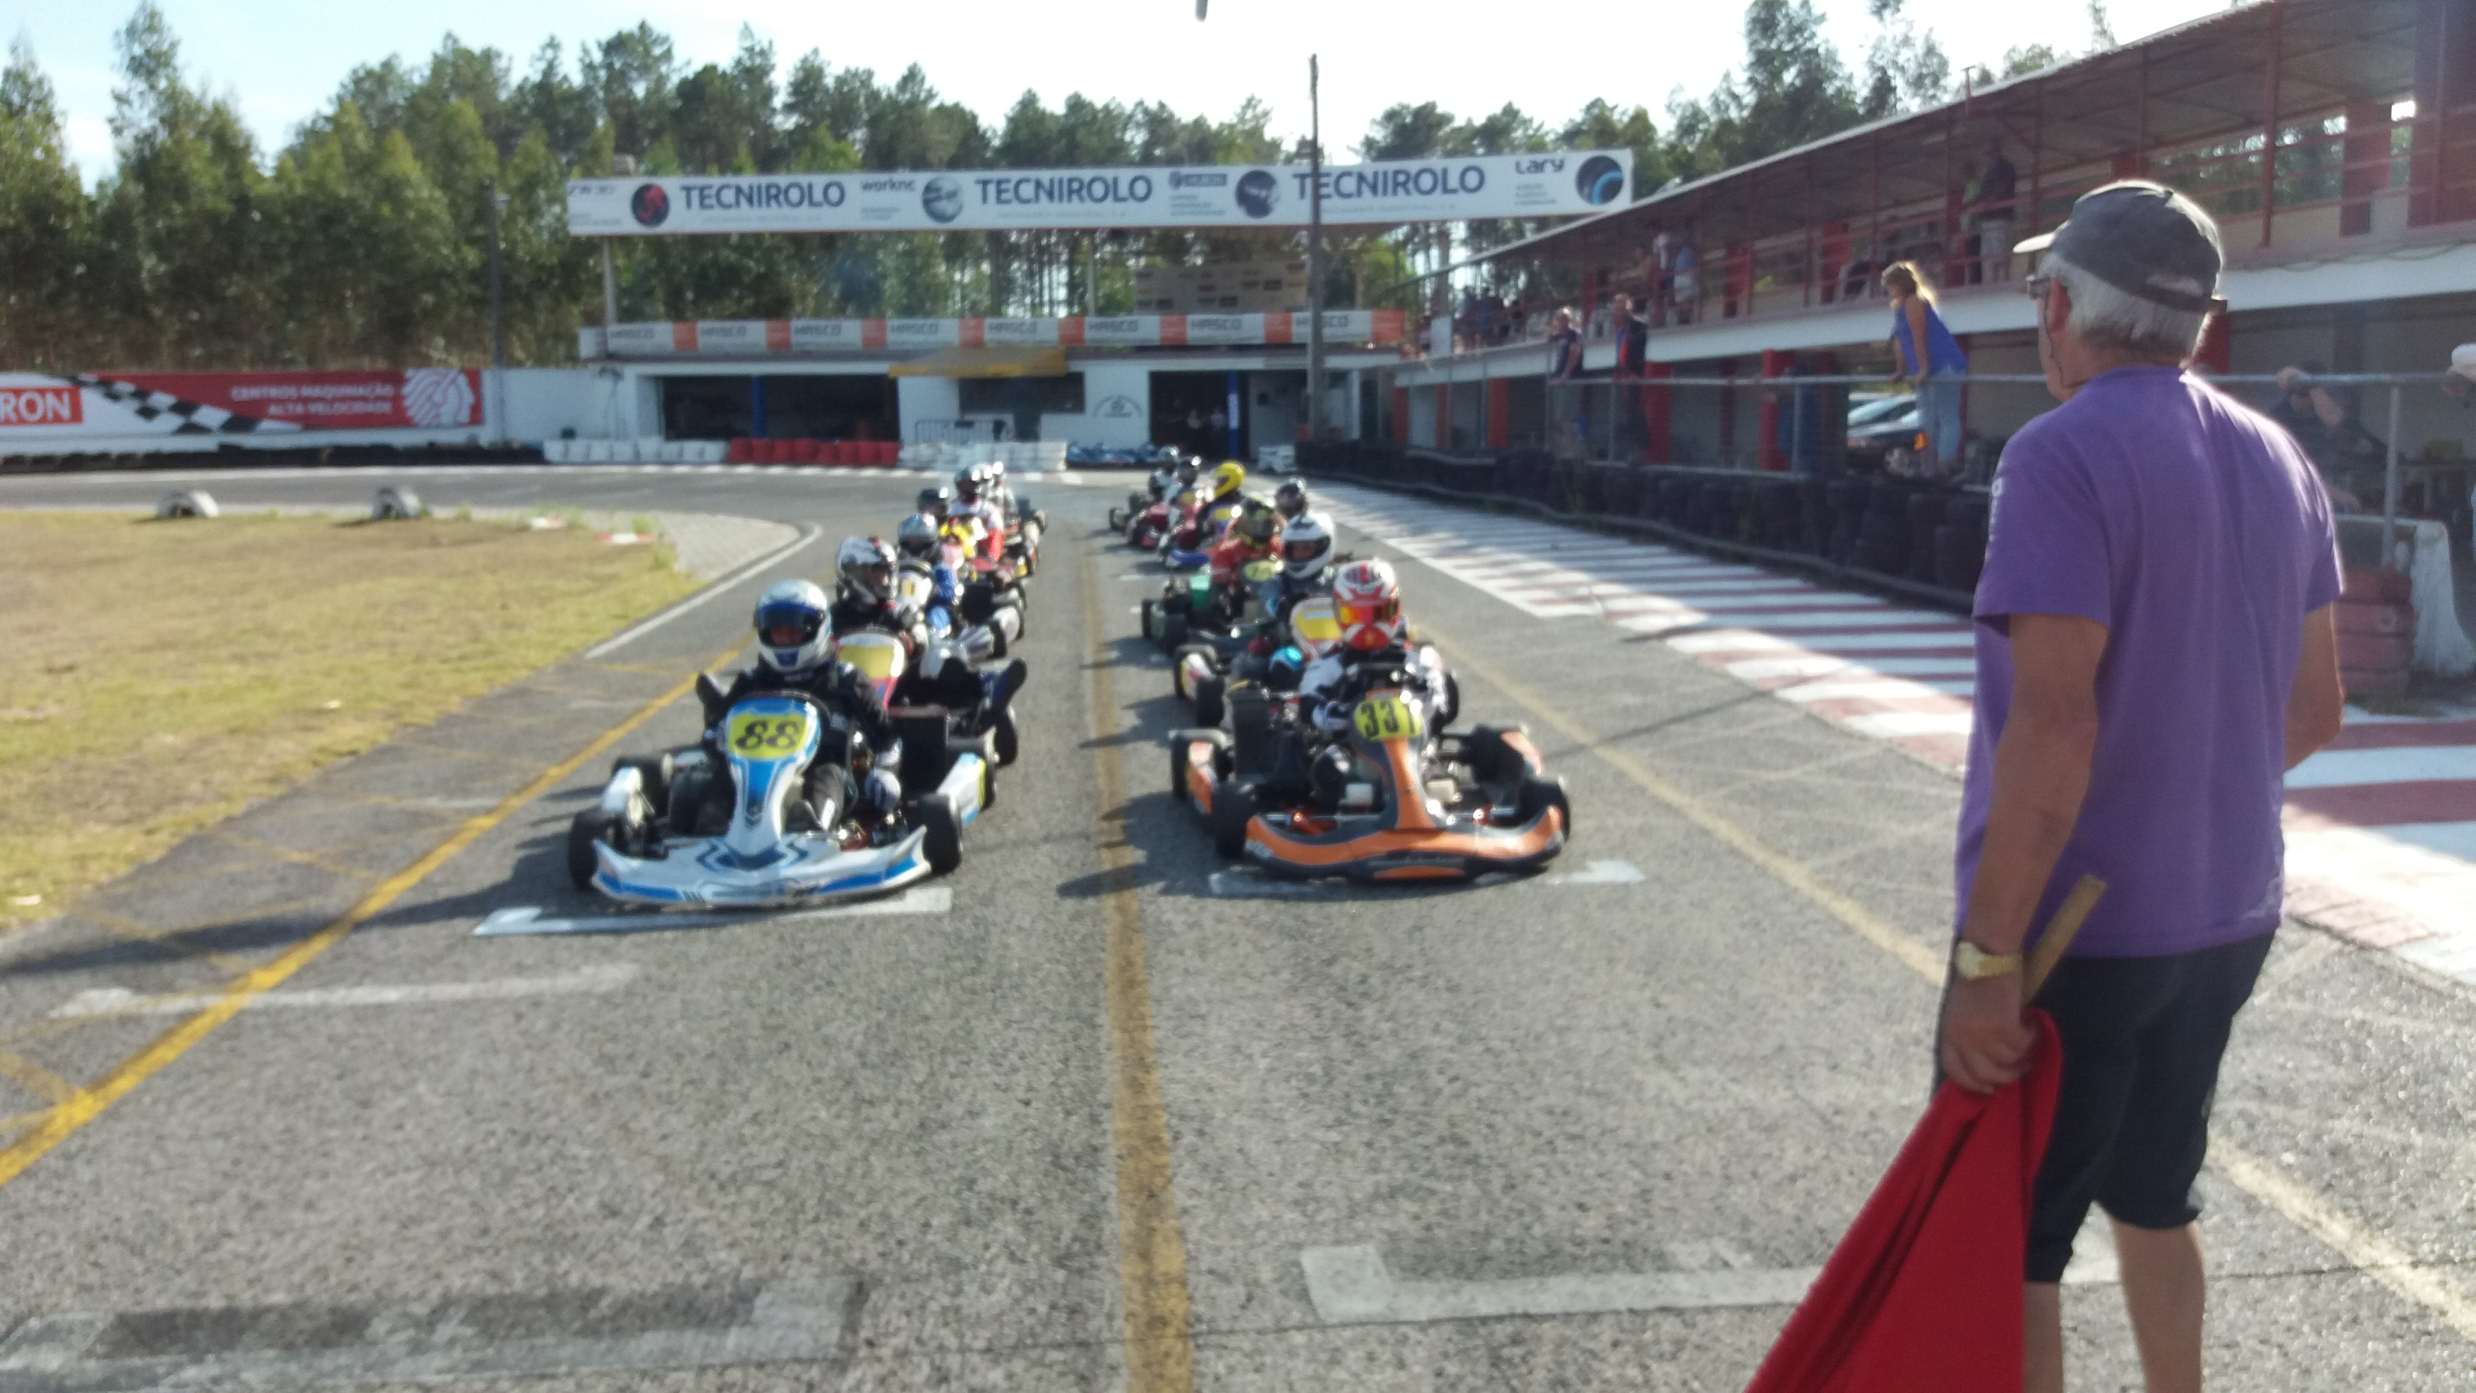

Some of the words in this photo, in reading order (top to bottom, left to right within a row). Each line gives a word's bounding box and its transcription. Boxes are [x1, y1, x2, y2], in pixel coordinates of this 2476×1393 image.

[680, 181, 845, 210] TECNIROLO
[975, 175, 1153, 205] TECNIROLO
[1292, 165, 1486, 200] TECNIROLO
[736, 719, 799, 750] 88
